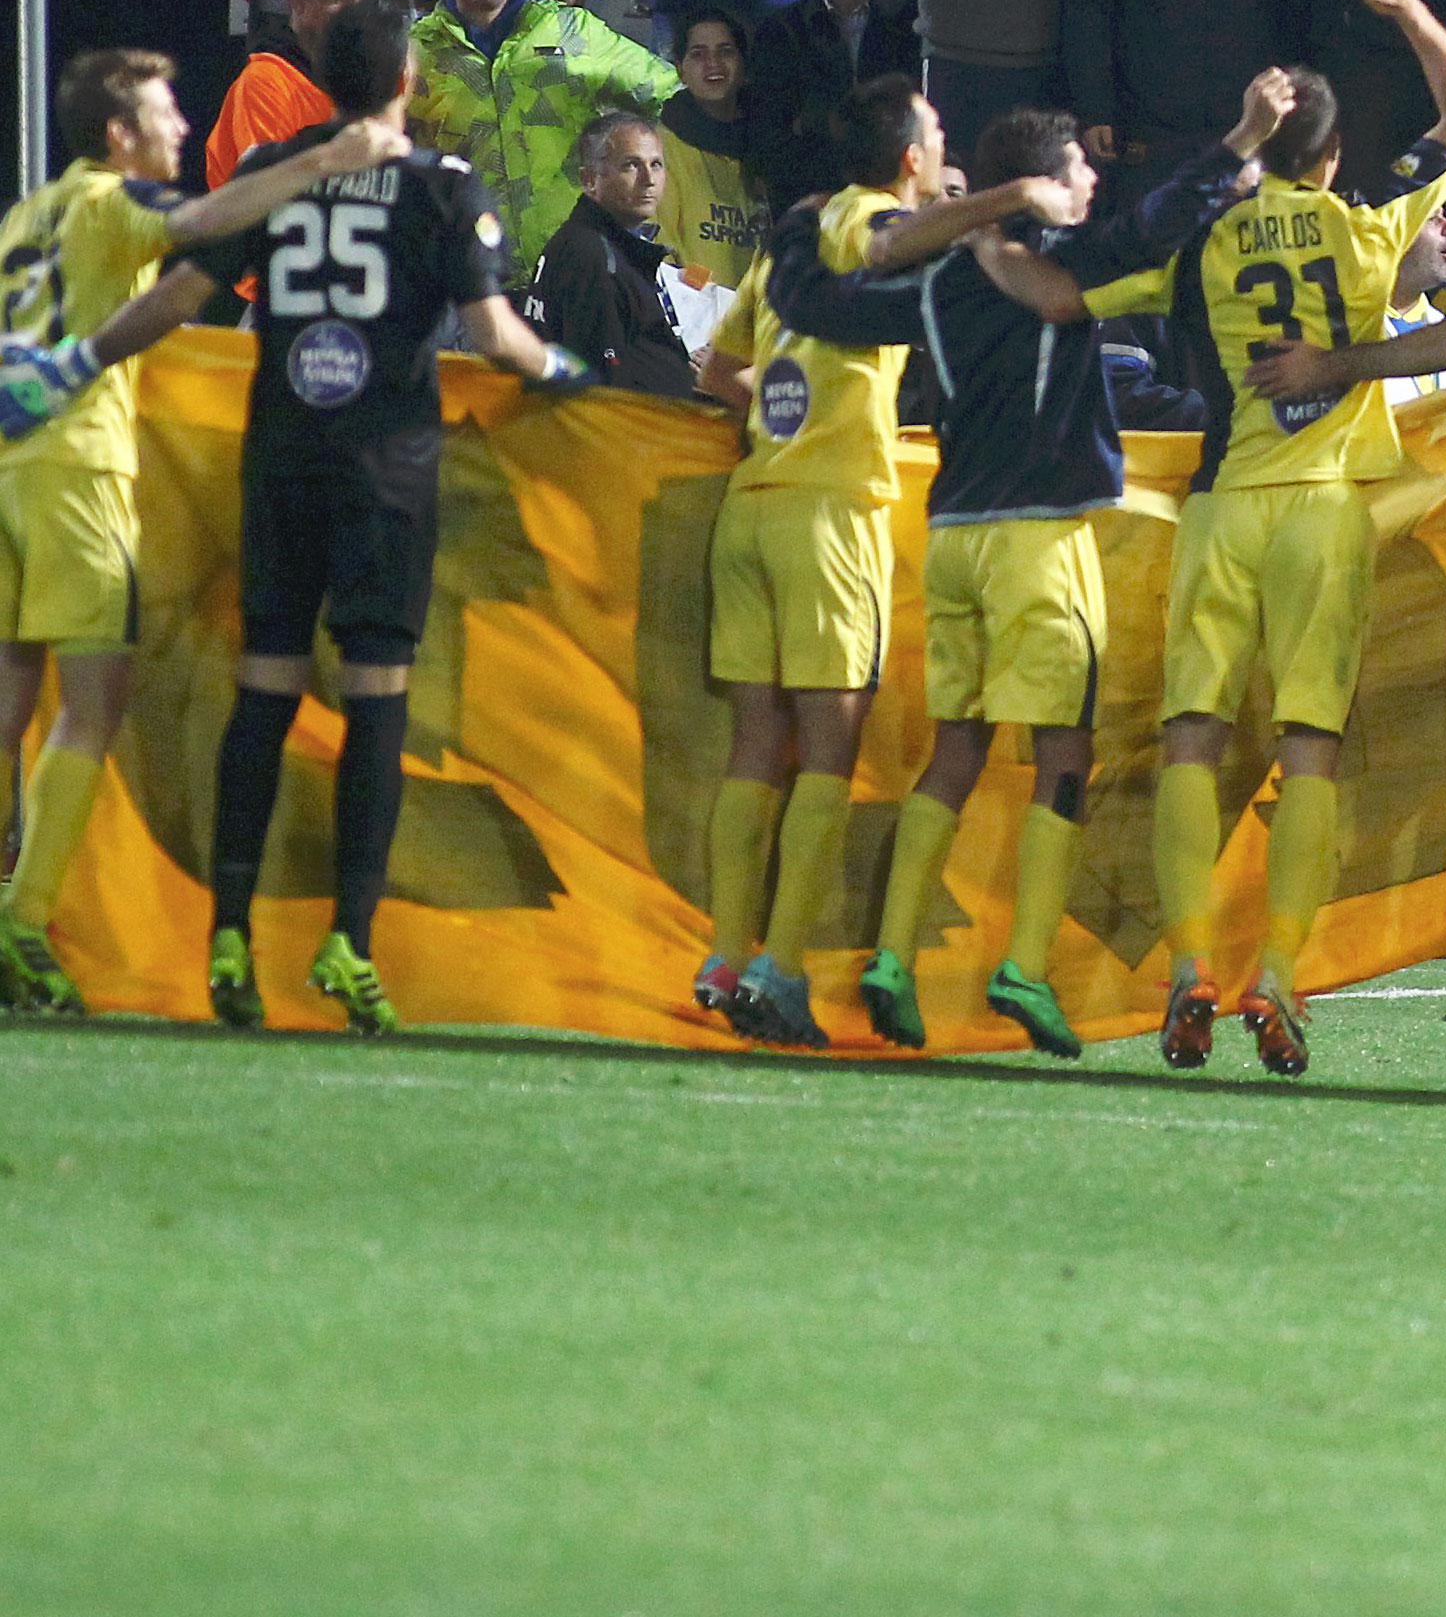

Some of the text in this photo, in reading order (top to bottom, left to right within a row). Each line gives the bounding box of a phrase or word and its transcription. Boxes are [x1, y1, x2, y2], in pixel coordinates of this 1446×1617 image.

[710, 202, 747, 227] MTA
[1237, 211, 1322, 254] CARLOS
[268, 201, 391, 320] 25
[1235, 256, 1351, 362] 31
